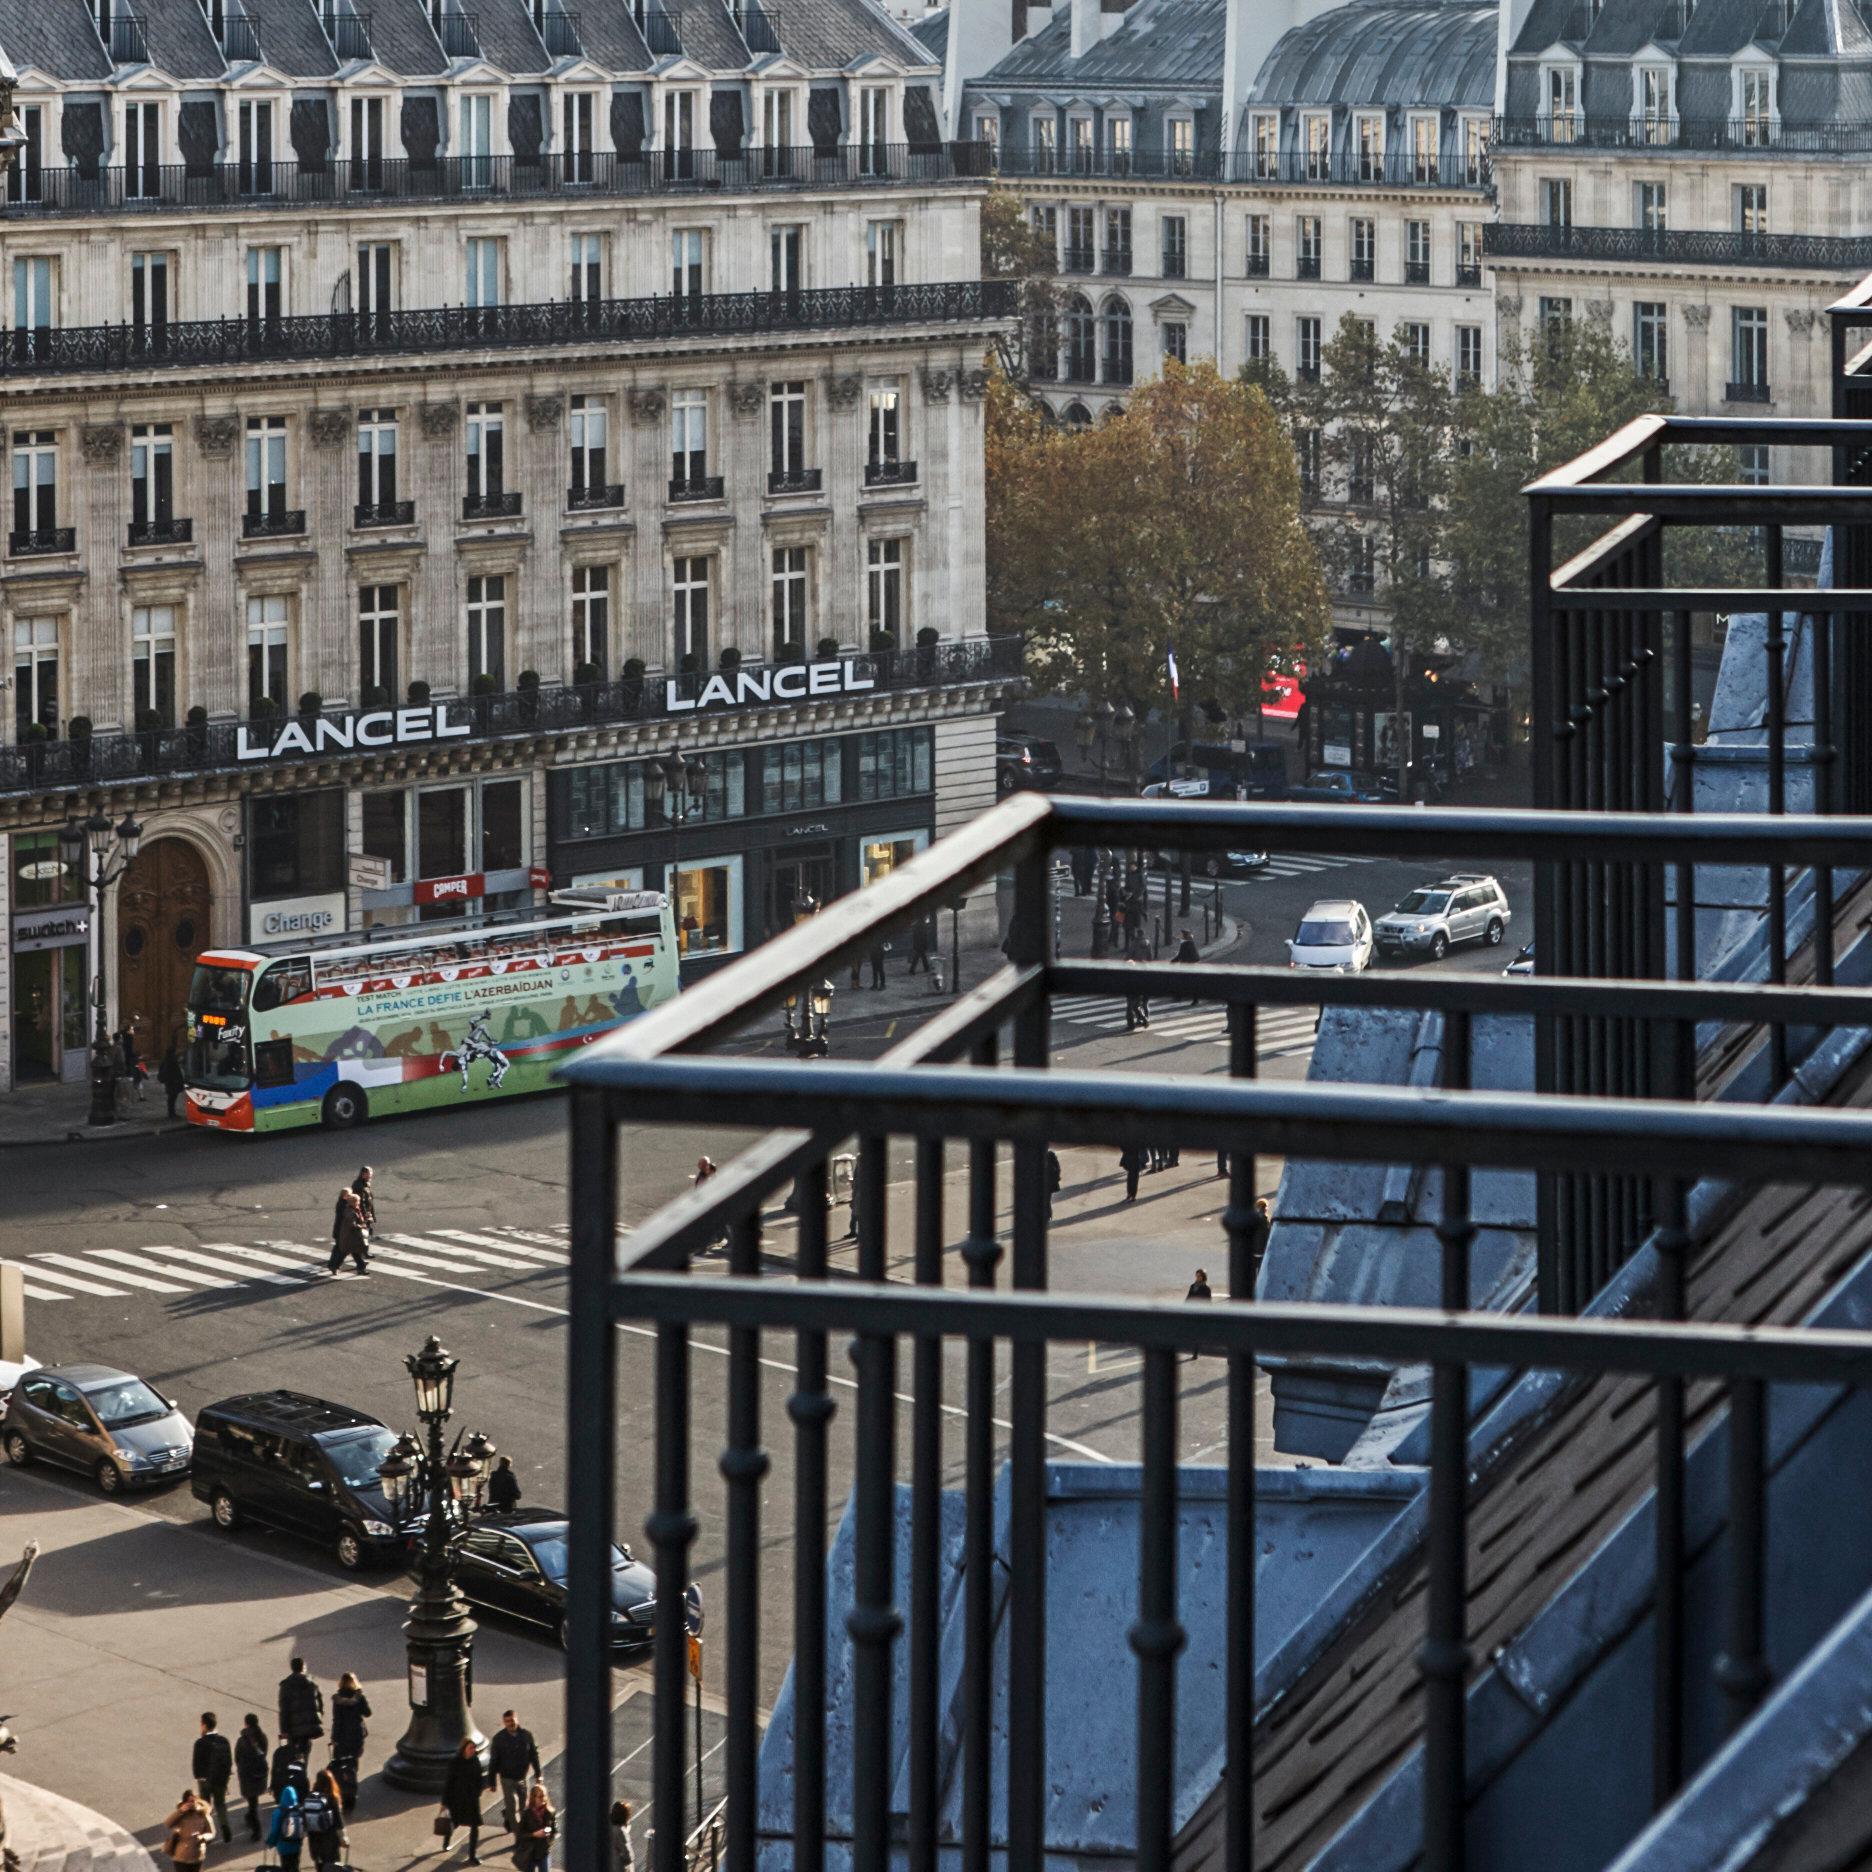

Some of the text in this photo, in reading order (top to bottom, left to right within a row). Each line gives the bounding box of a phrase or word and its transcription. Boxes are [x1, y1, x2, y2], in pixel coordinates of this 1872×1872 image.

[666, 660, 875, 711] LANCEL
[237, 705, 471, 760] LANCEL
[434, 880, 467, 898] CAMPER
[264, 911, 332, 934] Change
[356, 991, 401, 1003] TEST MATCH
[357, 1005, 373, 1016] LA
[376, 997, 424, 1013] FRANCE
